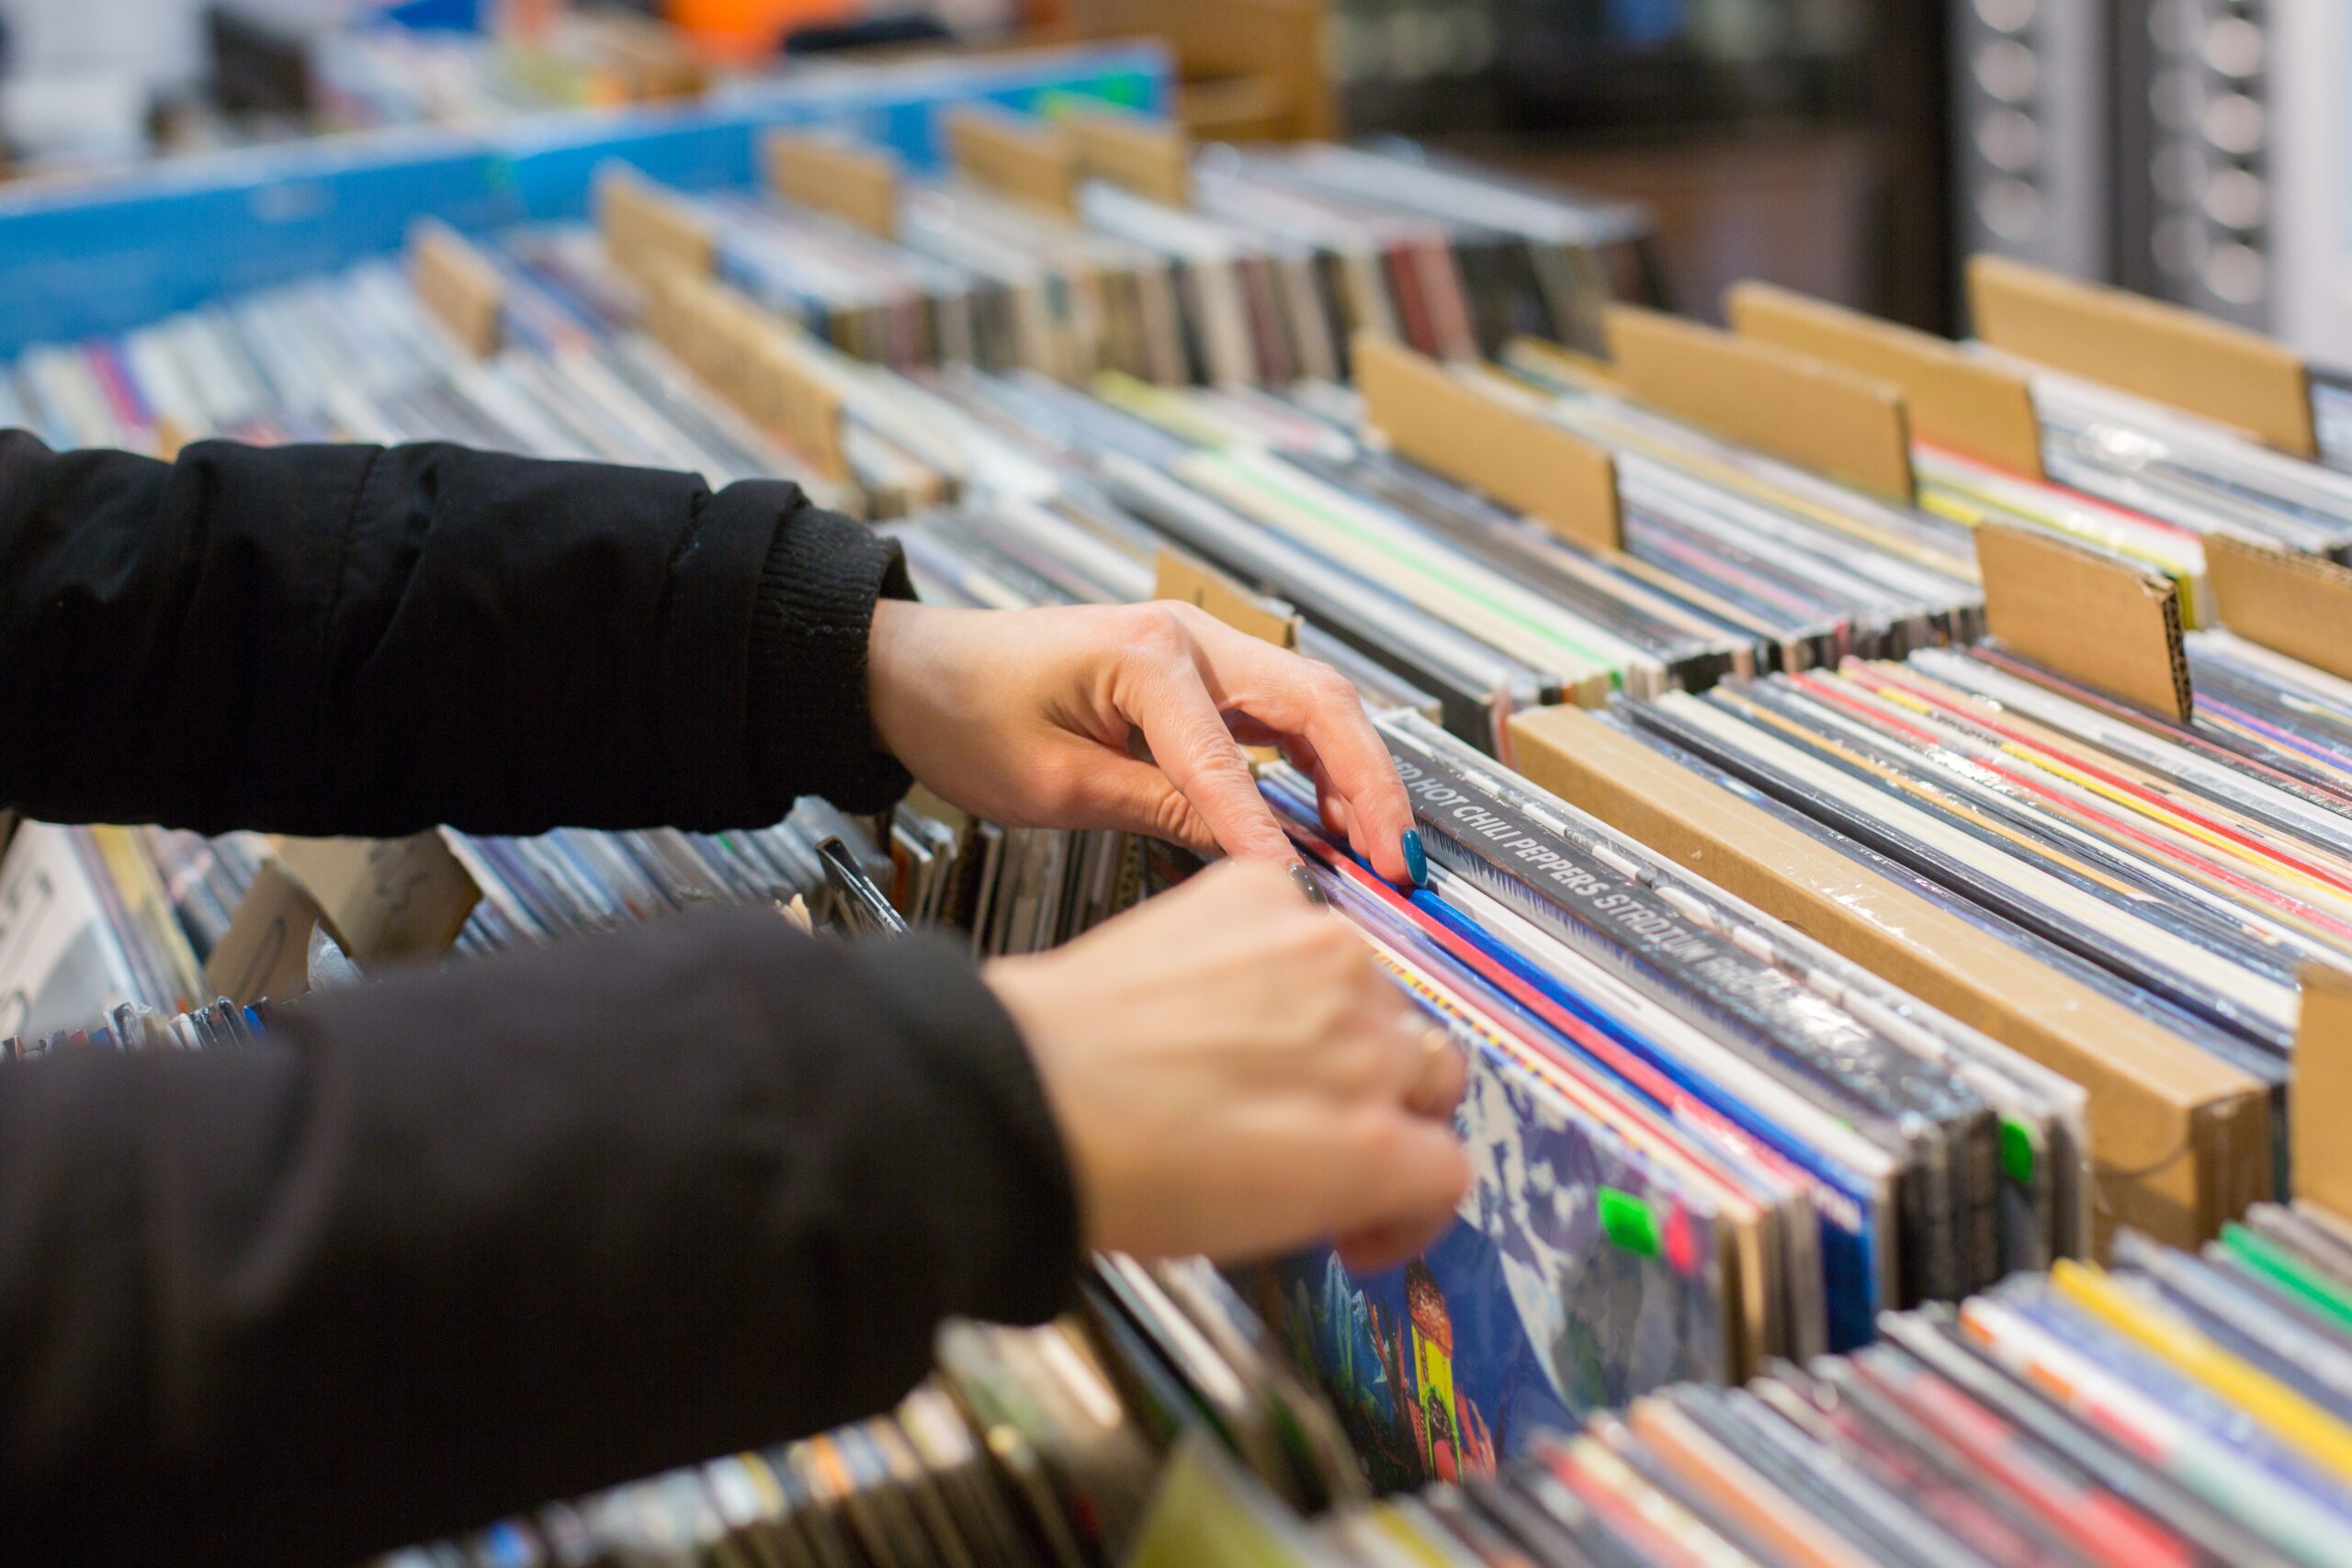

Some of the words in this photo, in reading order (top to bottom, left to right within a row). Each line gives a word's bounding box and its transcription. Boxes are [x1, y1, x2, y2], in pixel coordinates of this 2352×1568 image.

[1408, 777, 1469, 807] HOT
[1453, 805, 1521, 848] CHILI
[1515, 837, 1611, 897] PEPPERS
[1592, 893, 1718, 963] STADIUM
